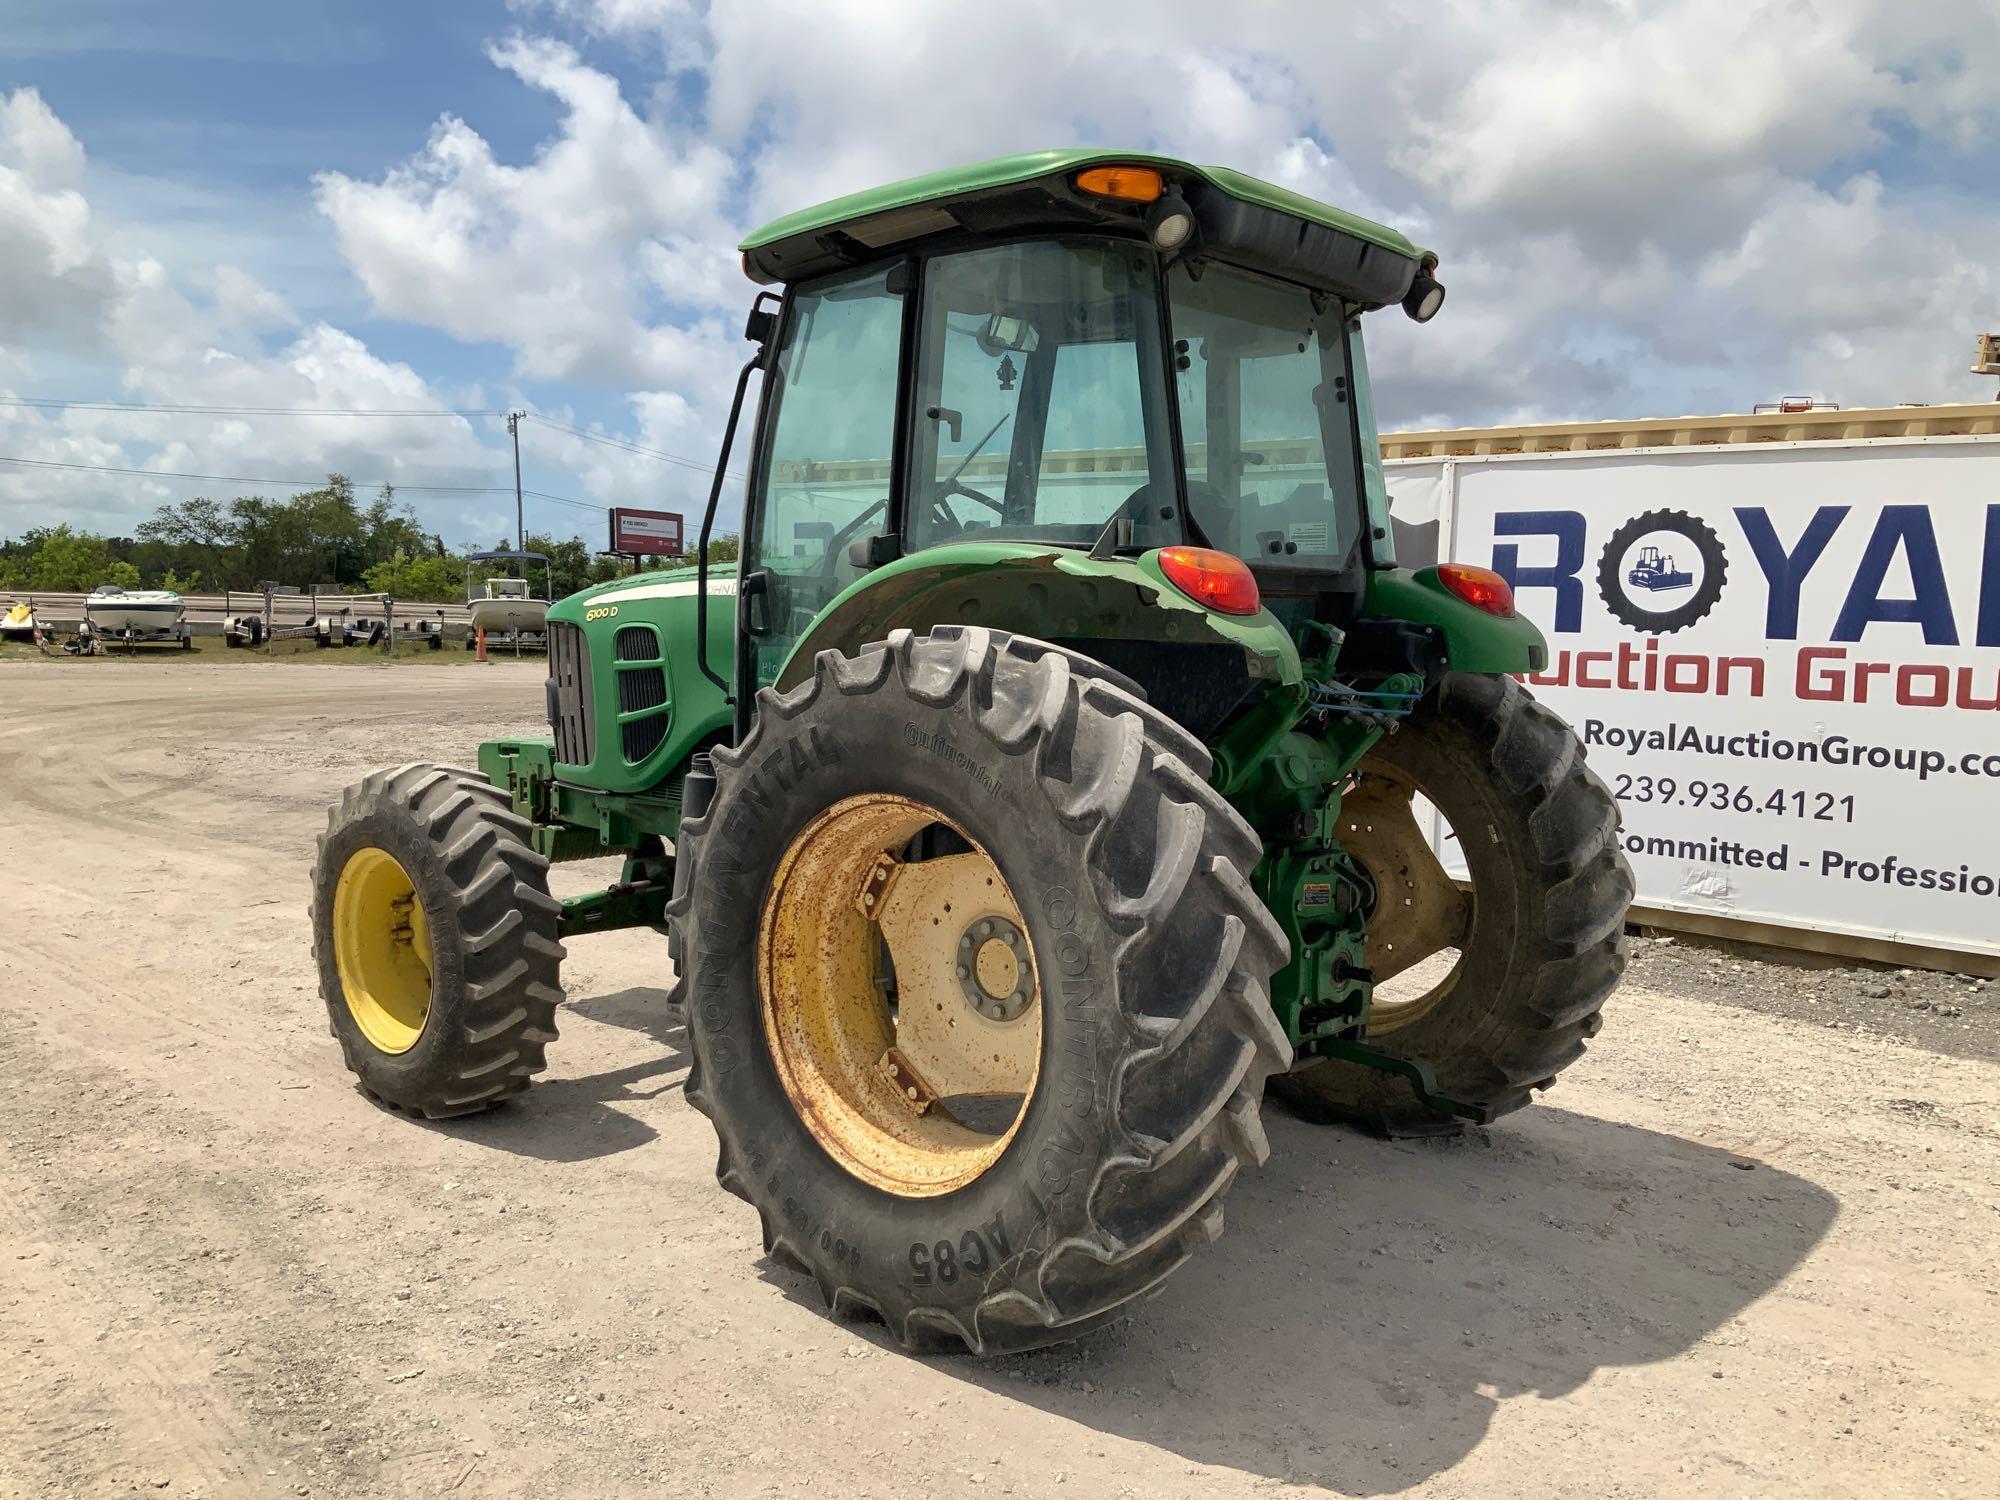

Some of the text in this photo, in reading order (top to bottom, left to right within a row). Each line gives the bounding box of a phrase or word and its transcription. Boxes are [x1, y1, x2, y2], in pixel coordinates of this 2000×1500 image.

[587, 606, 618, 622] 6100 D
[1504, 638, 1765, 697] uction
[1614, 773, 1854, 823] 239.936.4121
[696, 725, 842, 1075] CONTINENTAL
[1821, 850, 2000, 897] Professio
[909, 1208, 1013, 1288] AC85
